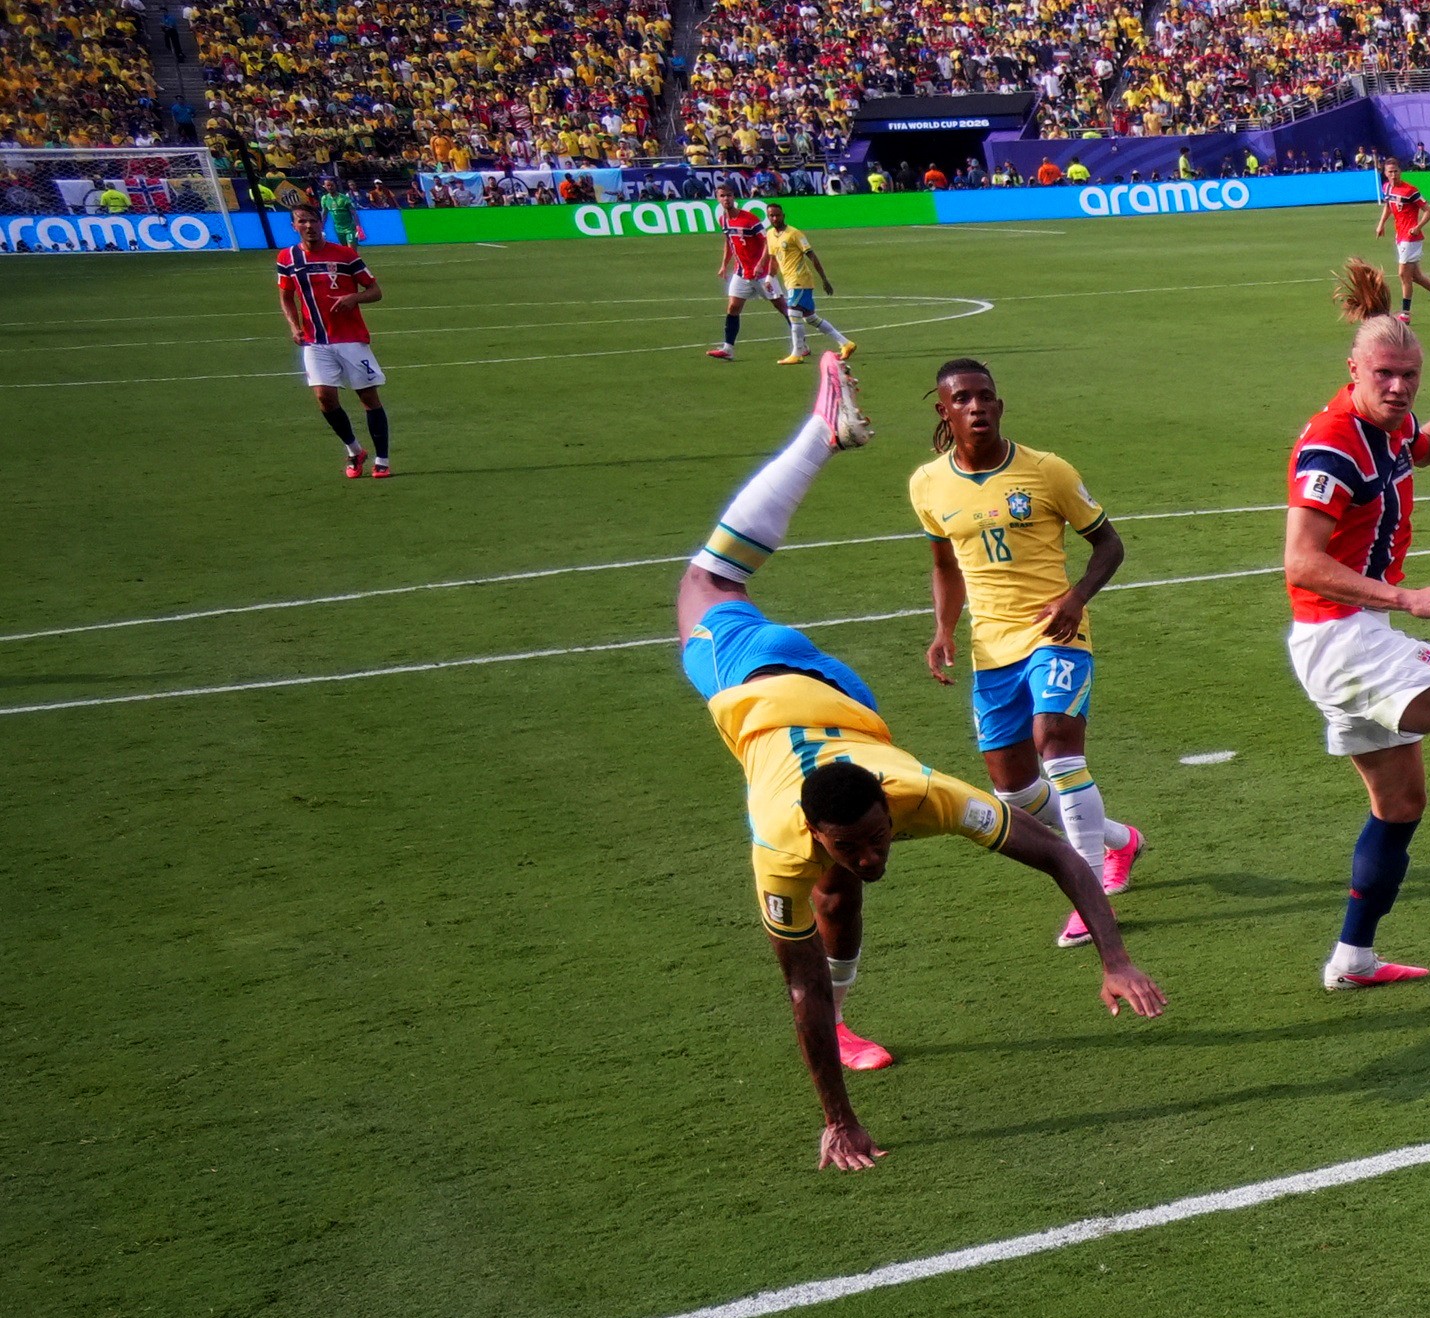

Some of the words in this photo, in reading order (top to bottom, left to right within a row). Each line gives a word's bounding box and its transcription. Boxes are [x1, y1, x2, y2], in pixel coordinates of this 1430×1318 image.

[888, 122, 908, 130] FIFA
[908, 121, 940, 130] WORLD
[941, 120, 958, 128] CUP
[959, 119, 990, 128] 2026
[1079, 180, 1250, 216] aramco
[0, 216, 210, 250] ramco
[361, 359, 375, 375] 8
[980, 527, 1013, 563] 18
[1048, 658, 1075, 691] 18
